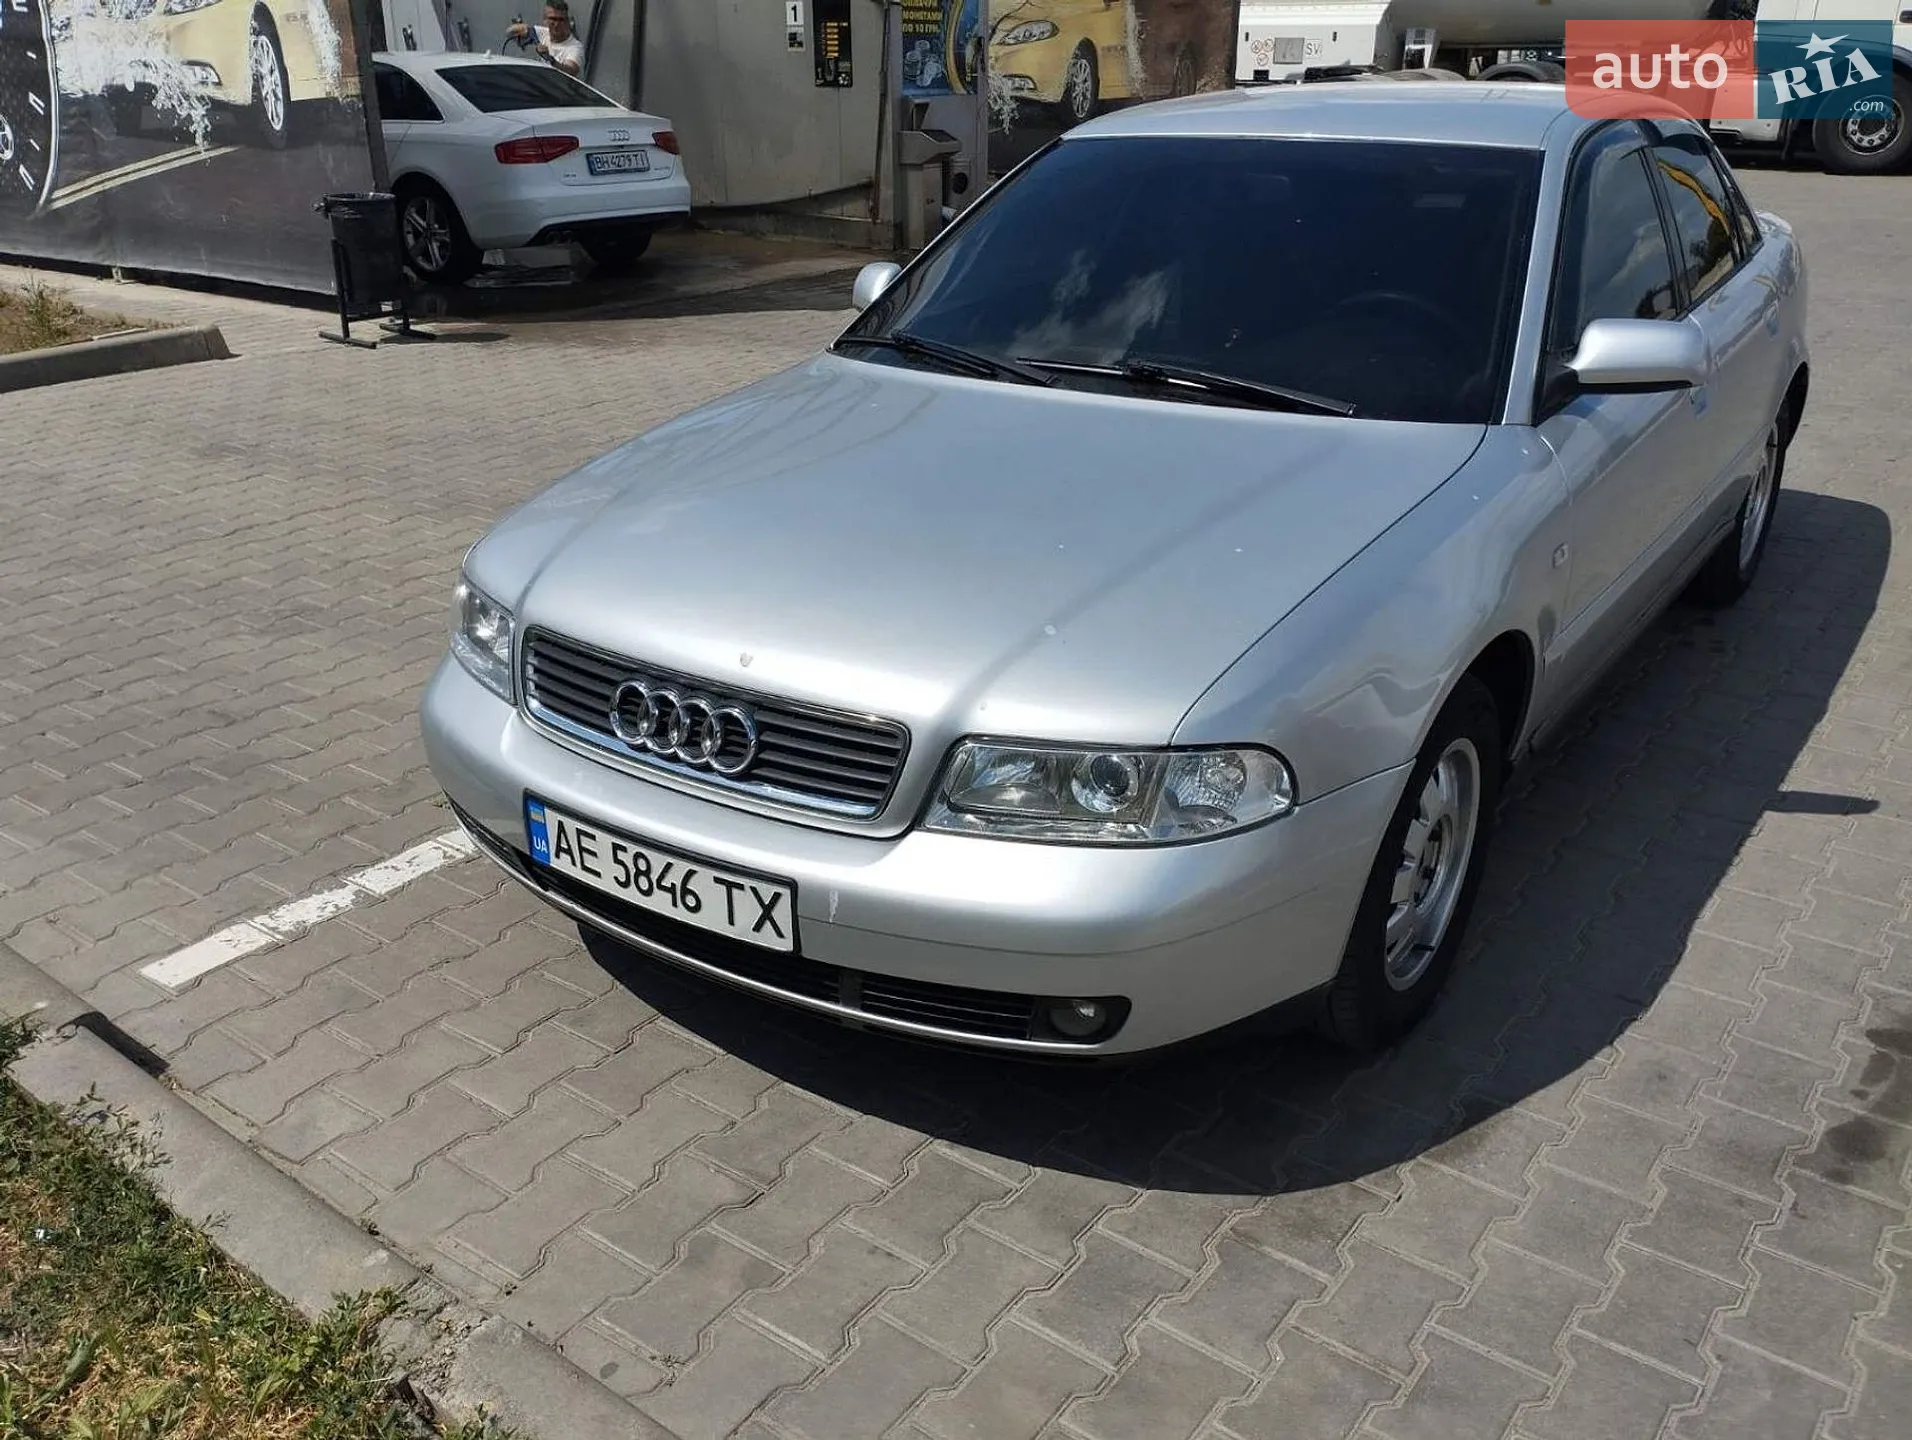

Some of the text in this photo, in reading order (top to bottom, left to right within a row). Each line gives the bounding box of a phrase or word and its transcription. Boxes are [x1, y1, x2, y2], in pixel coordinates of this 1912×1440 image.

[791, 3, 797, 22] 1
[534, 837, 548, 854] UA
[554, 820, 785, 939] AE 5846 TX
